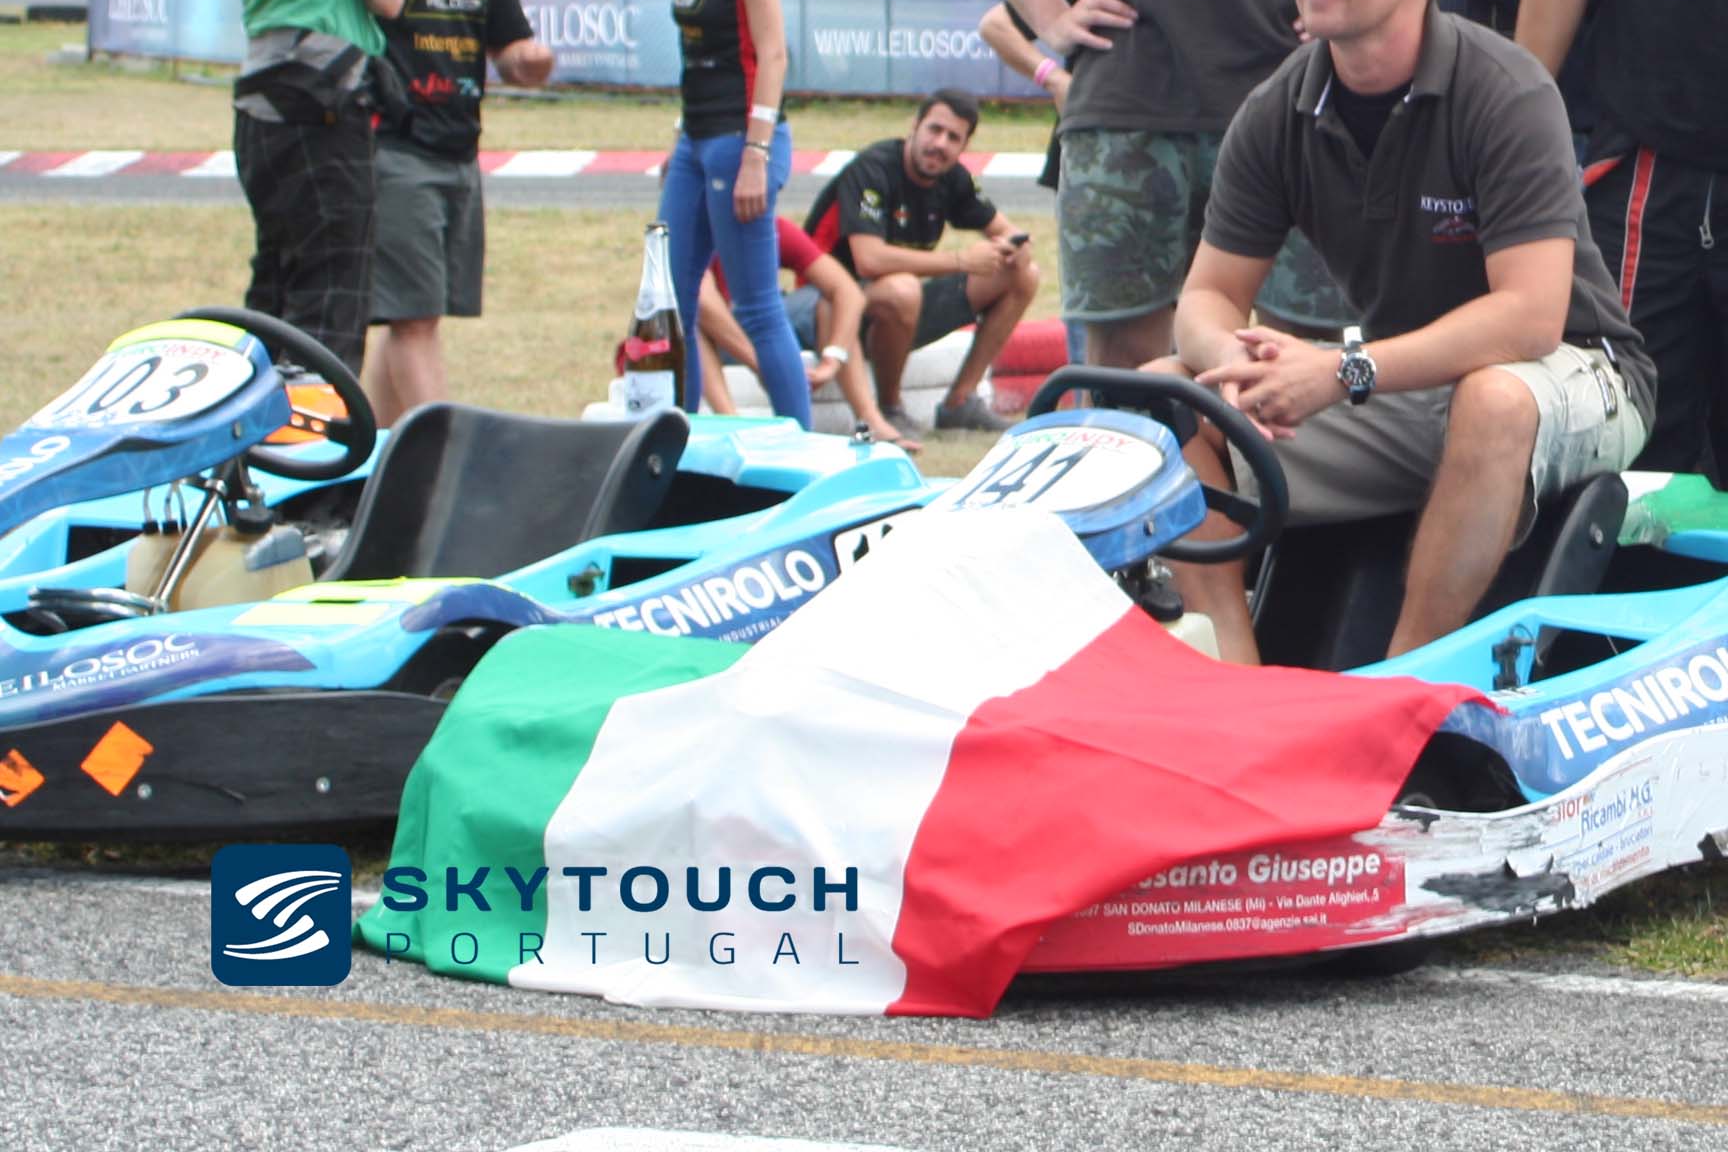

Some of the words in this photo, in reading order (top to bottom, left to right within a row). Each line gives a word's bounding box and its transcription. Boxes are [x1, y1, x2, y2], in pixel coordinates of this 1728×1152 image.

[54, 355, 210, 415] 103
[954, 442, 1096, 505] 141
[592, 549, 826, 638] TECNIROLO
[1580, 789, 1627, 835] Ricambi
[1247, 851, 1381, 885] Giuseppe
[1103, 901, 1128, 917] SAN
[1131, 898, 1180, 915] DONATO
[1184, 896, 1243, 913] MILANESE
[1277, 894, 1293, 908] Via
[1295, 892, 1326, 907] Dante
